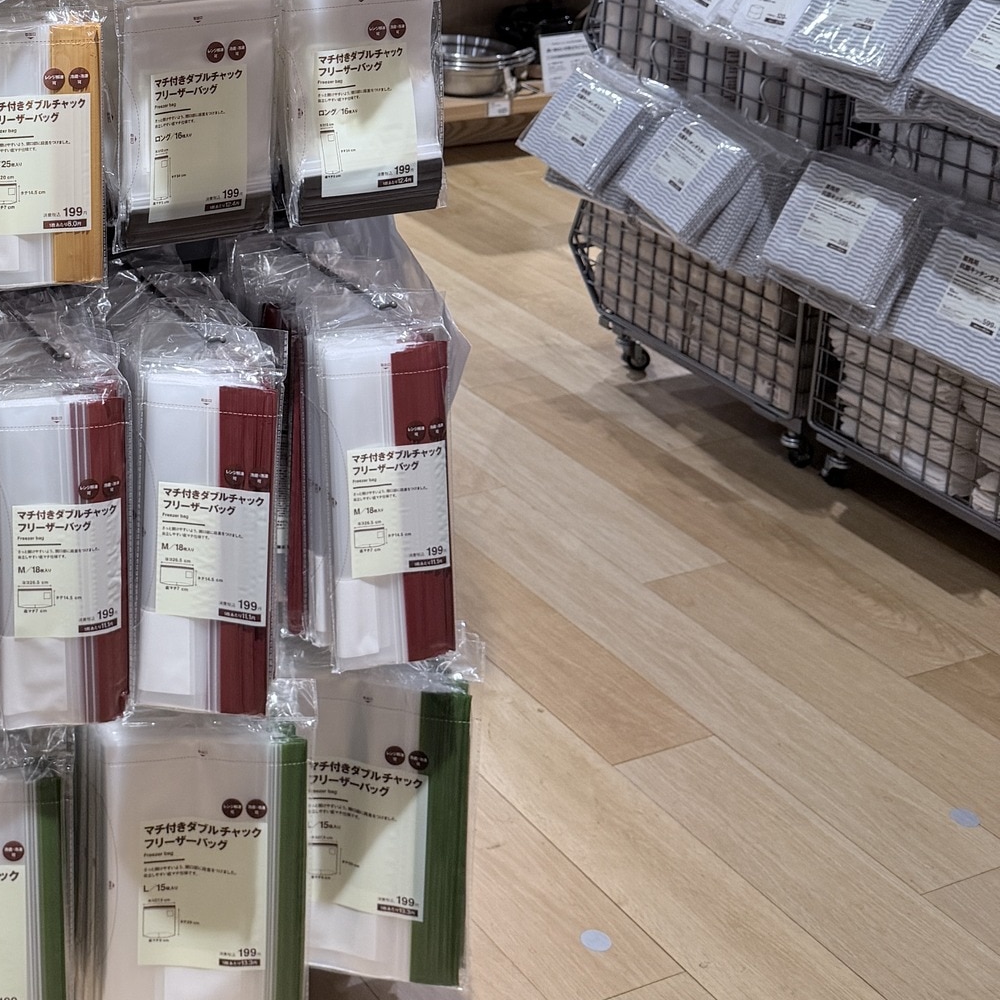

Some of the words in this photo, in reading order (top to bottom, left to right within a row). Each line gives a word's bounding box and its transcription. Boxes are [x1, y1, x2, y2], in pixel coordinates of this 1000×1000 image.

[318, 48, 403, 64] マチ付きダブルチャック
[318, 62, 382, 77] フリーザーバッグ
[155, 69, 243, 88] マチ付きダブルチャック
[155, 84, 217, 101] フリーザーバッグ
[352, 447, 442, 462] マチ付きダブルチャック
[352, 461, 419, 476] フリーザーバッグ
[163, 488, 264, 506] マチ付きダブルチャック
[17, 505, 117, 520] マチ付きダブルチャック
[163, 500, 235, 515] フリーザーバッグ
[18, 521, 91, 533] フリーザーバッグ
[144, 822, 262, 838] マチ付きダブルチャック
[145, 836, 228, 850] フリーザーバッグ
